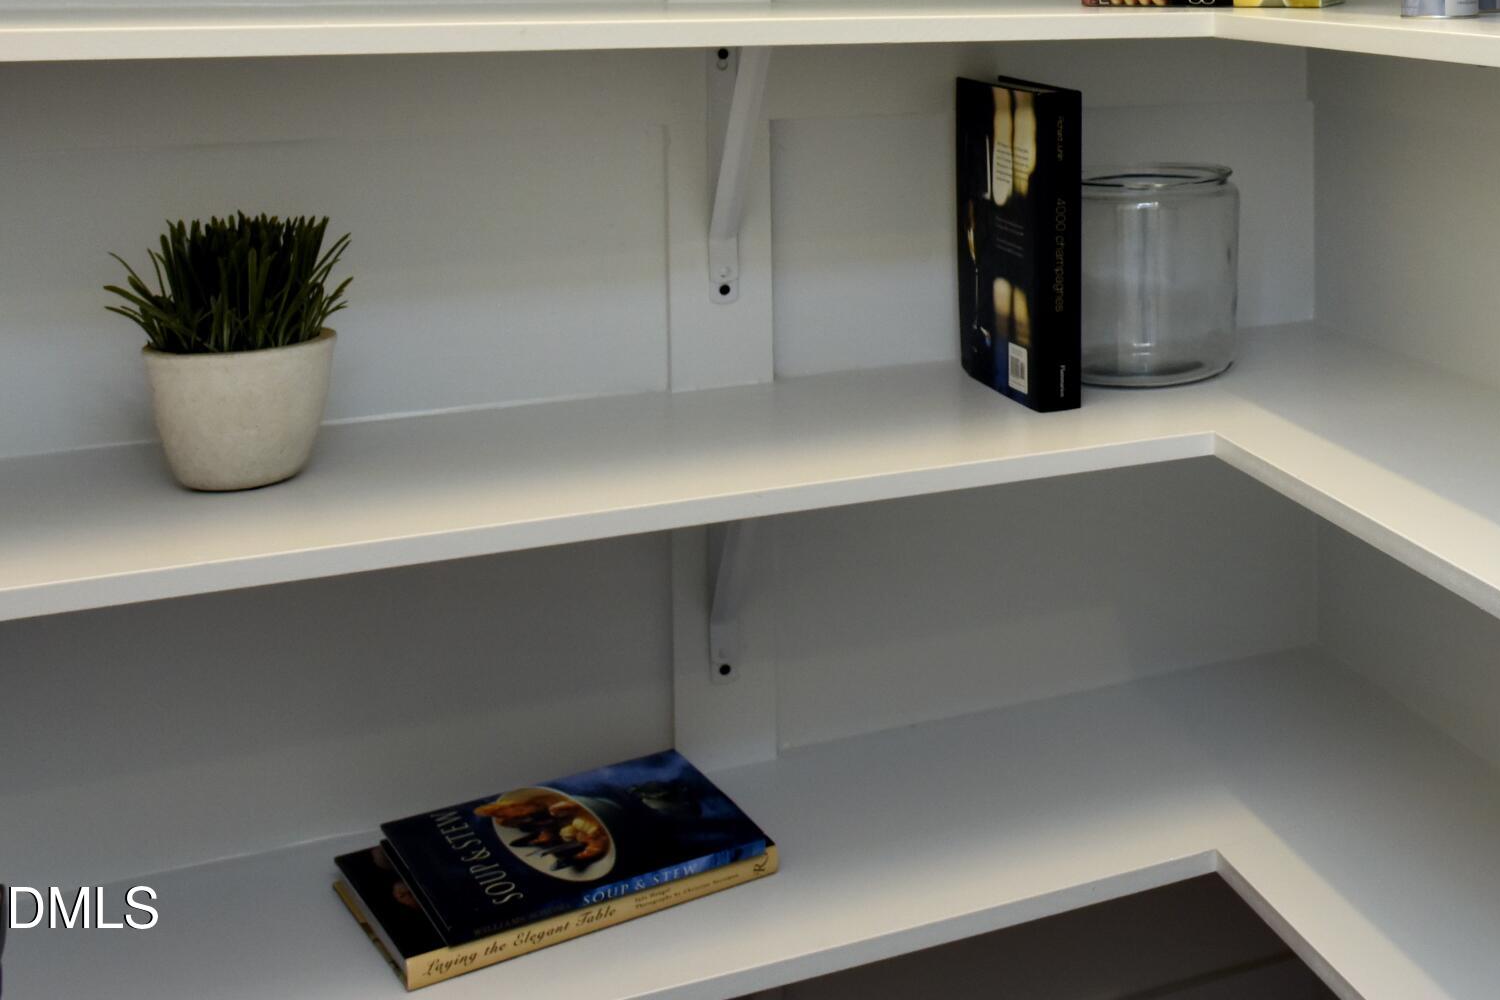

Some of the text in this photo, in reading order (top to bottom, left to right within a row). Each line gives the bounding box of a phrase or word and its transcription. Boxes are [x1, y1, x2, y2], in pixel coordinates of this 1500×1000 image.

[430, 811, 482, 850] STEW
[469, 863, 523, 904] SOUP
[582, 883, 629, 905] SOUP
[654, 864, 696, 884] STEW
[422, 951, 478, 977] Laying
[484, 941, 505, 957] the
[513, 922, 569, 947] Elegant
[575, 905, 617, 928] Table
